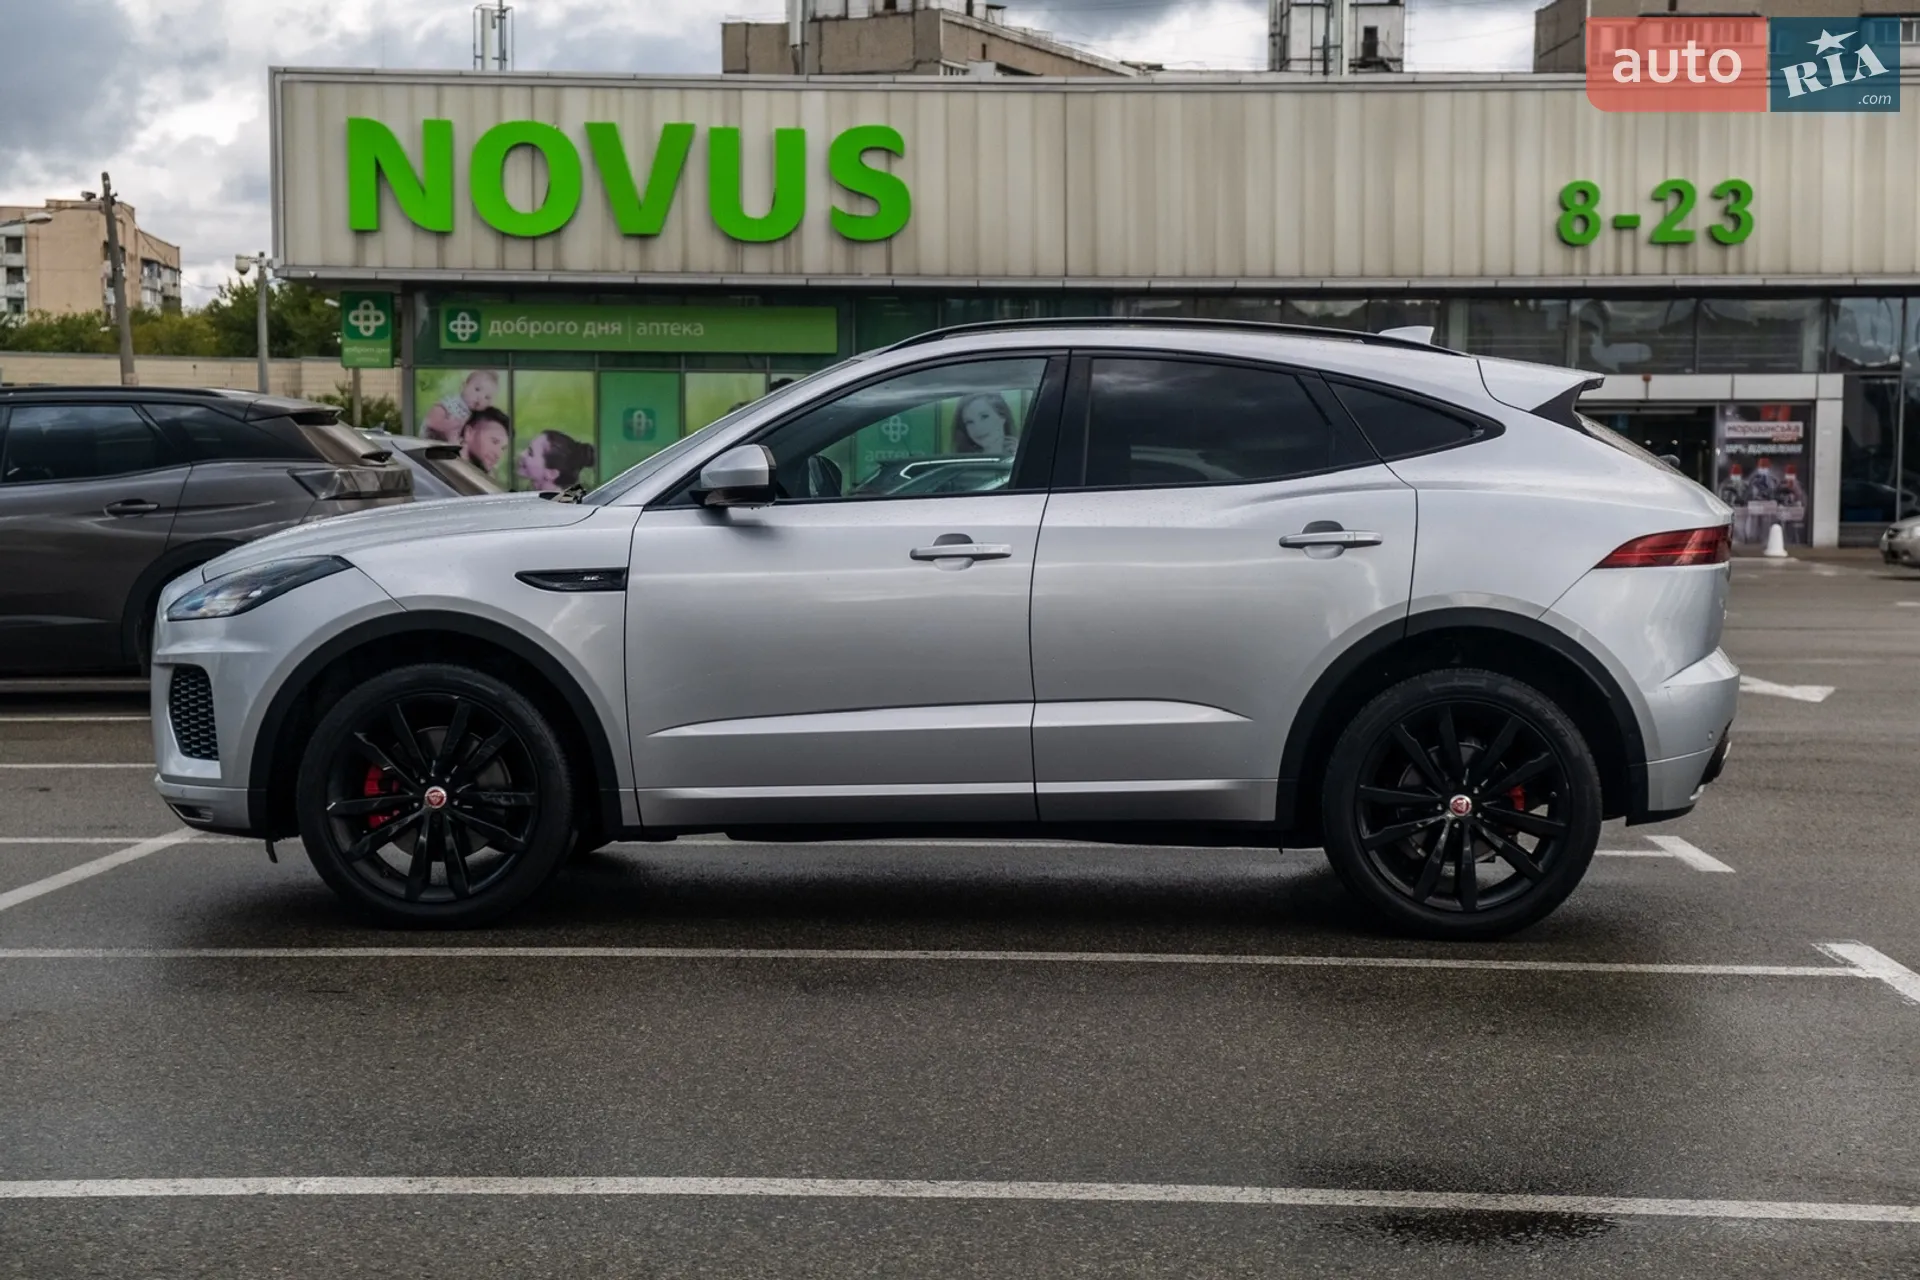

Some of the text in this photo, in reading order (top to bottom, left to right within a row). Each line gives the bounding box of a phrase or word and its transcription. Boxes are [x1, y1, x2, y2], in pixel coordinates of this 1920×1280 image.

[347, 116, 911, 242] NOVUS
[1557, 178, 1755, 246] 8-23
[488, 316, 705, 339] доброго дня аптека
